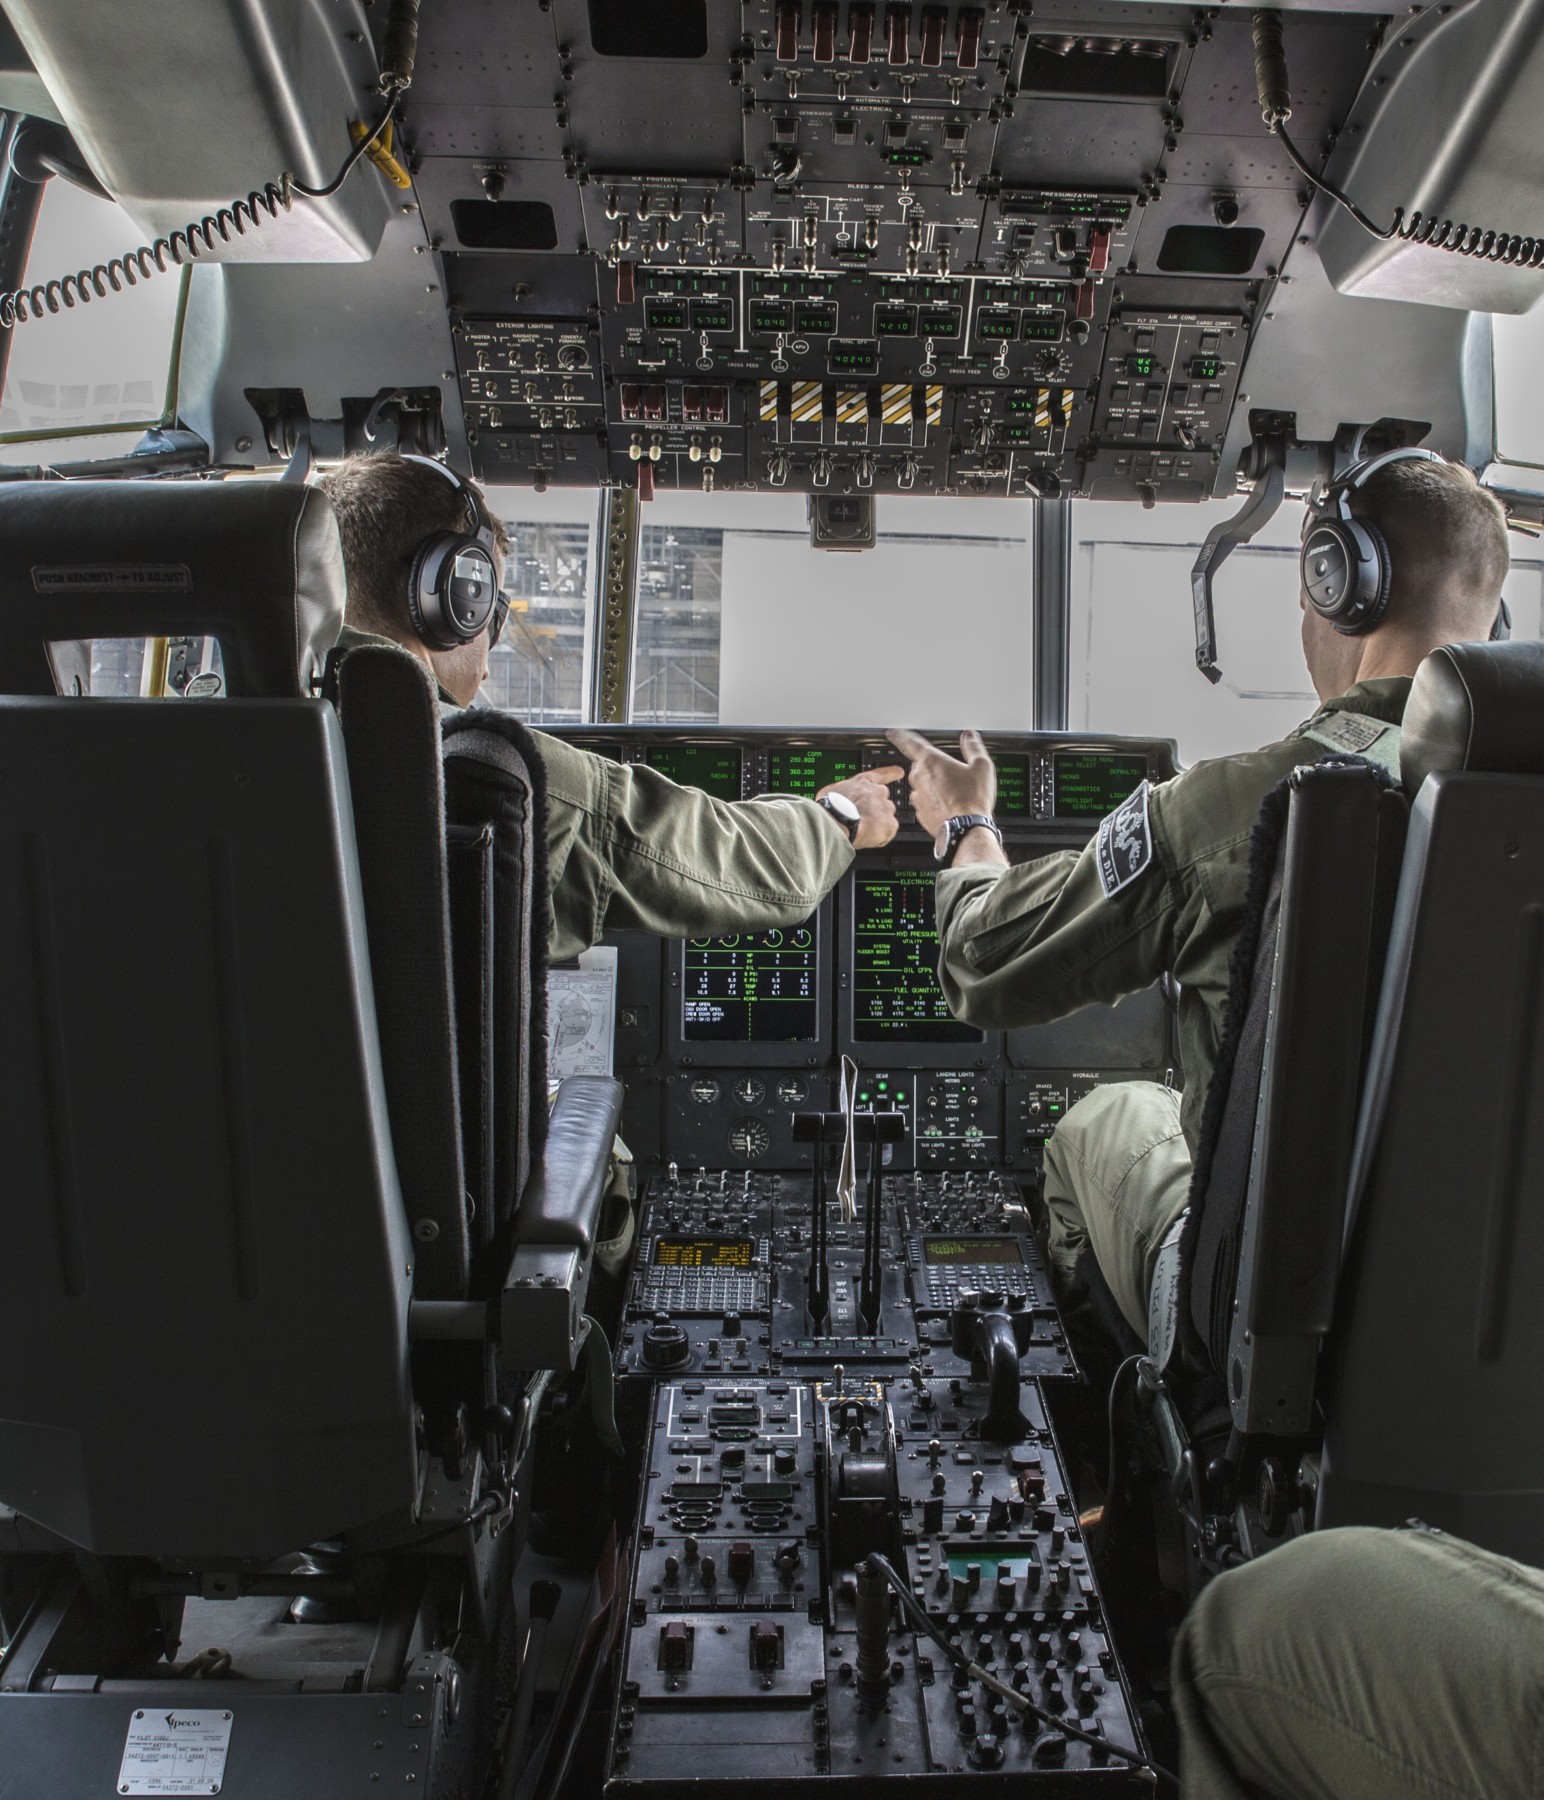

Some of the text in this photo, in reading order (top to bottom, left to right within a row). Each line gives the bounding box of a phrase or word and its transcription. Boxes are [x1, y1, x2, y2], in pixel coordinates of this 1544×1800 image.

[1040, 191, 1098, 199] PRESSURIZATION
[39, 572, 185, 584] PUSH HEADREST TO ADJUST
